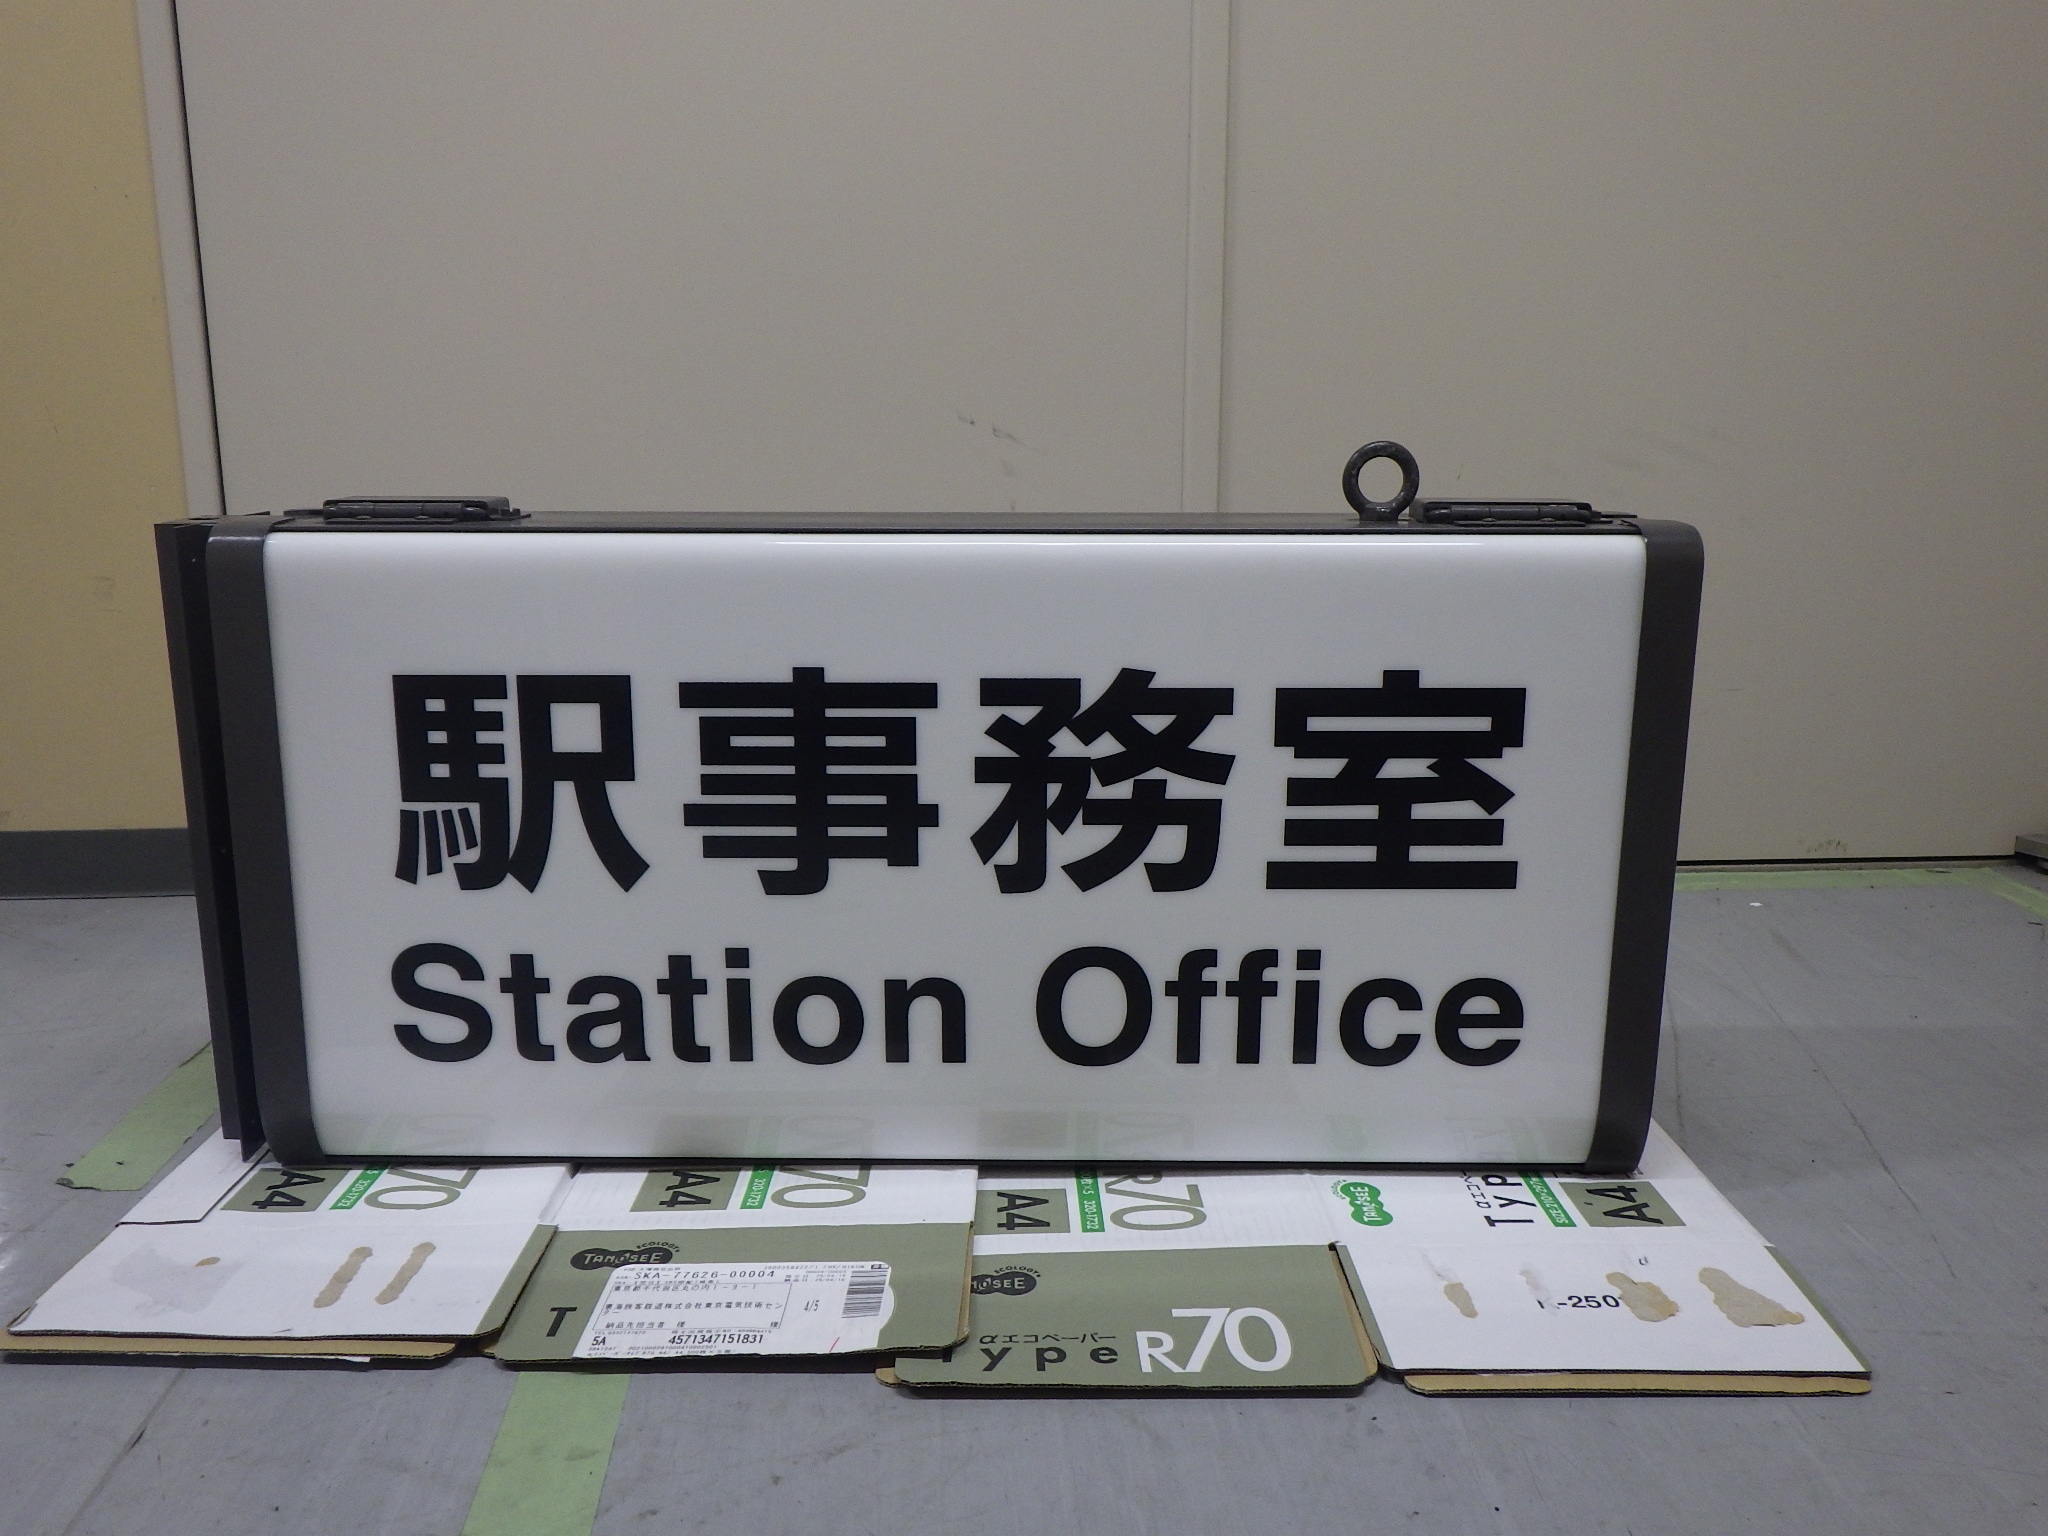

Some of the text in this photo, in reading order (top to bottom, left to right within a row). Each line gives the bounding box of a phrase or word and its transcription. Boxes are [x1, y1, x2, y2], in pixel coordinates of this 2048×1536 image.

[391, 666, 1527, 896] 駅事務室
[390, 942, 1525, 1068] Station Office
[251, 1170, 326, 1210] A4
[658, 1169, 721, 1208] A4
[1585, 1185, 1664, 1225] A4
[997, 1191, 1051, 1231] A4
[1086, 1199, 1100, 1230] 320-1732
[634, 1270, 776, 1280] SKA-77626-00004
[545, 1306, 578, 1338] T
[803, 1299, 820, 1313] 4/5
[591, 1335, 607, 1347] 5A
[668, 1332, 764, 1346] 4571347151831
[1135, 1306, 1293, 1374] R70
